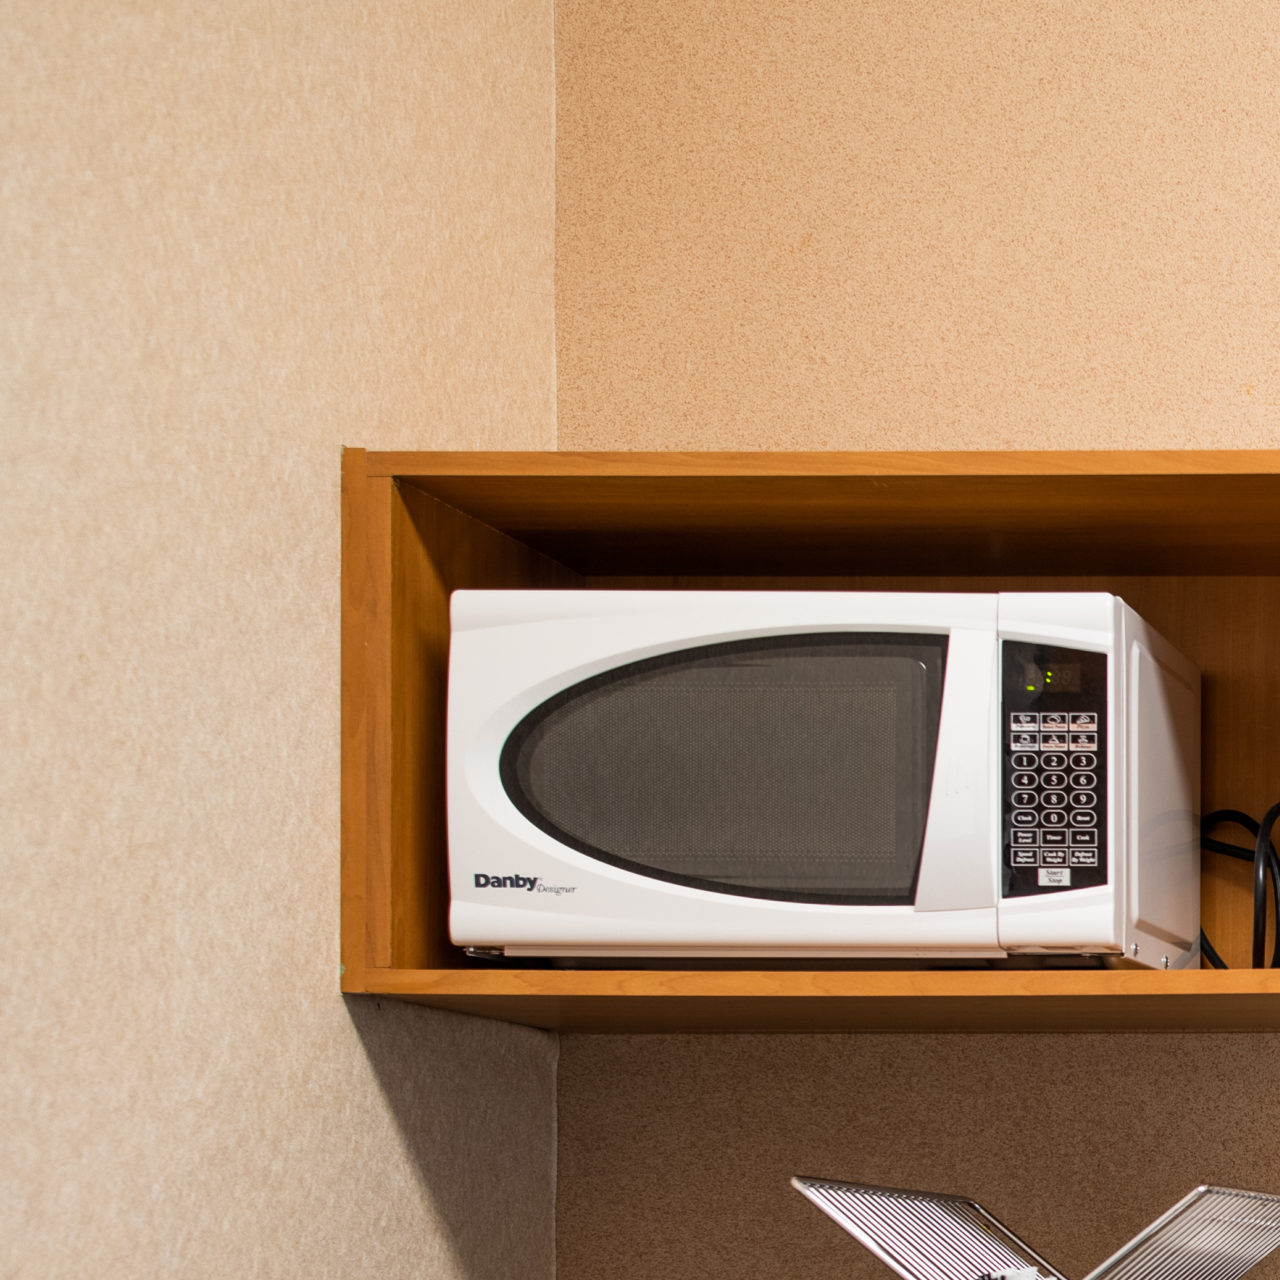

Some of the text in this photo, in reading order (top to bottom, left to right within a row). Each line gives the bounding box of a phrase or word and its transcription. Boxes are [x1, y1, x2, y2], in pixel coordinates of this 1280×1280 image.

[1022, 756, 1027, 766] 1
[1050, 756, 1058, 766] 2
[1080, 756, 1087, 766] 3
[1021, 775, 1028, 785] 4
[1050, 775, 1058, 785] 5
[1080, 775, 1087, 785] 6
[1021, 794, 1028, 804] 7
[1050, 794, 1058, 804] 8
[1080, 794, 1087, 804] 9
[1050, 813, 1058, 823] 0
[474, 874, 576, 896] Danby Designer
